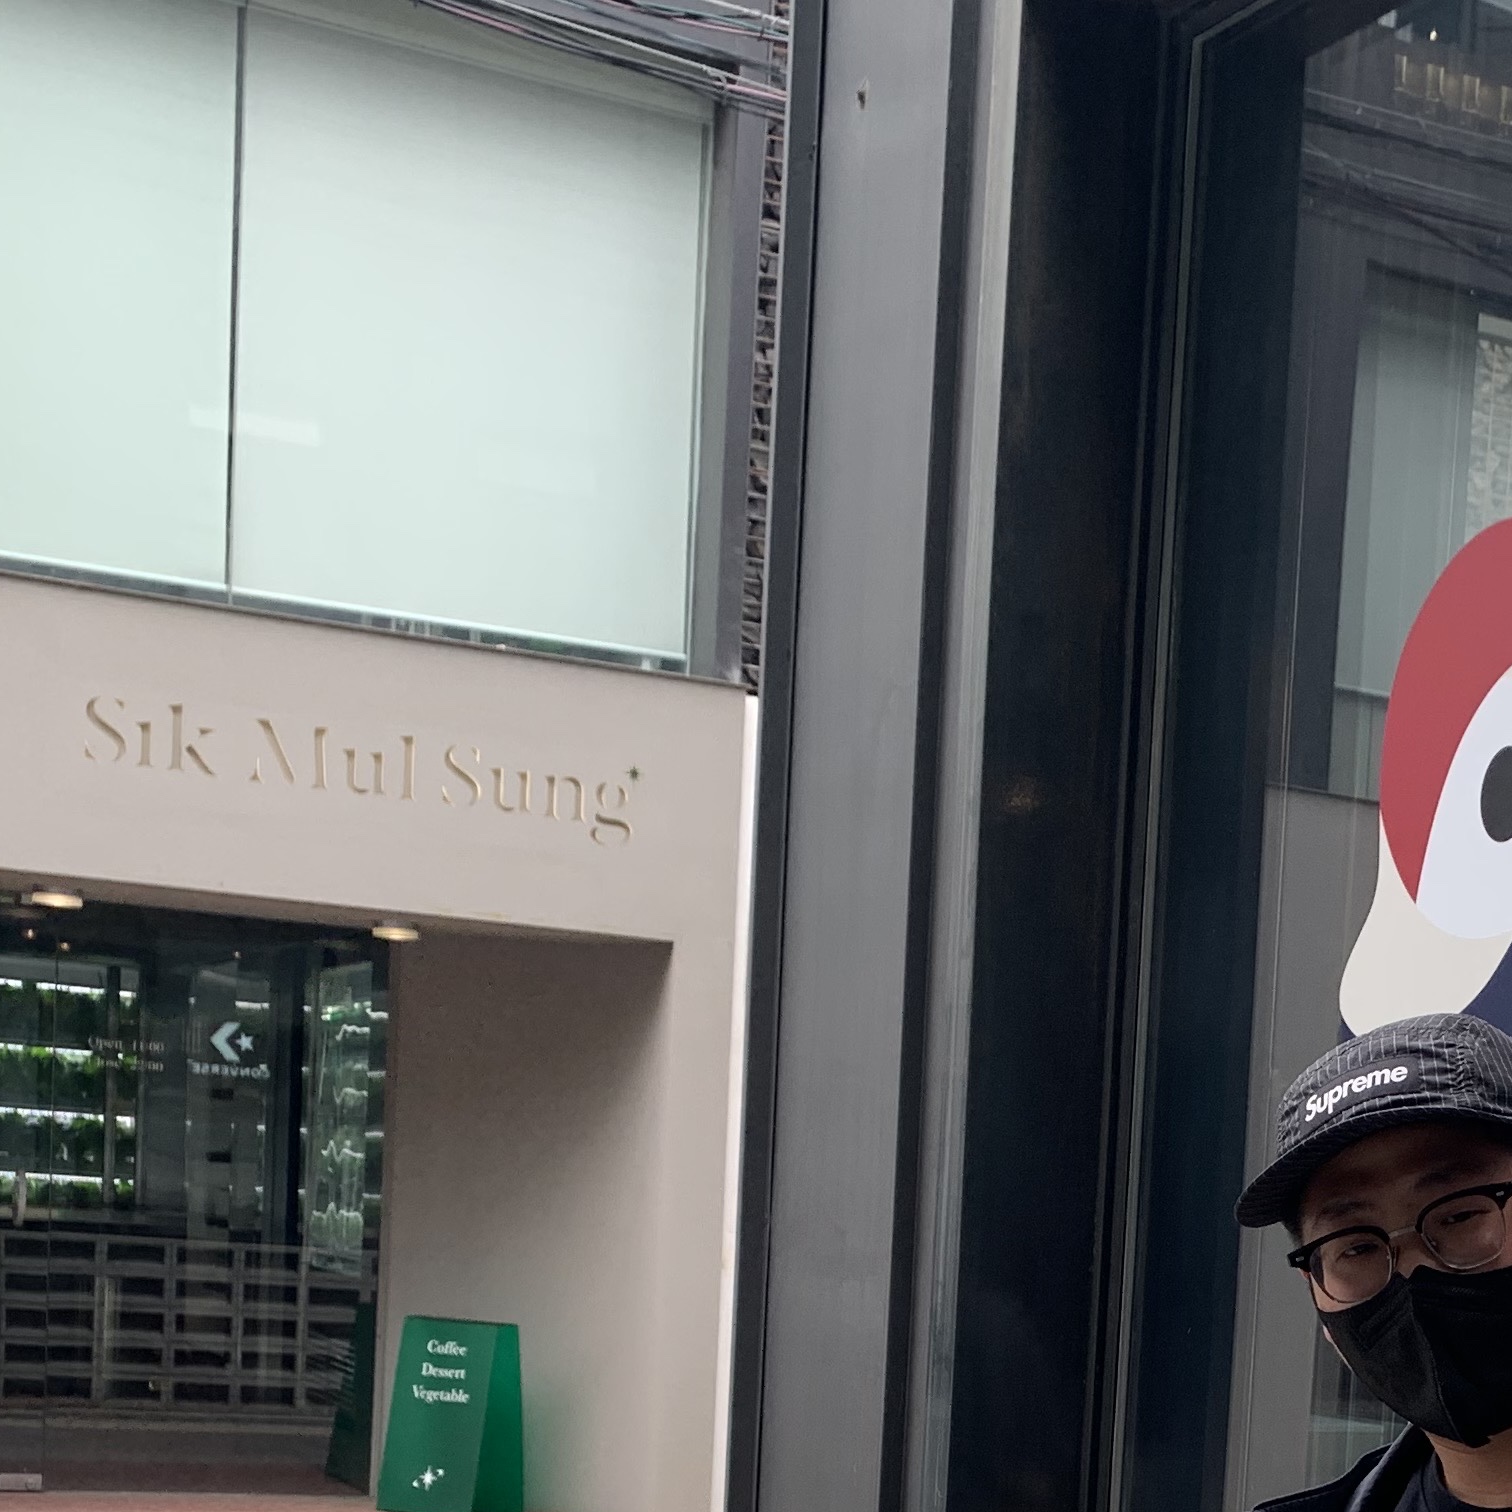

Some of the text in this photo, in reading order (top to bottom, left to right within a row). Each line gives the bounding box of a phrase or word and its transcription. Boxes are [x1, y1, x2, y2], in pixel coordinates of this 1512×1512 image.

[83, 696, 634, 846] Sik Mul Sung
[1304, 1065, 1409, 1122] Supreme
[426, 1338, 468, 1357] Coffee
[421, 1361, 467, 1380] Dessert
[411, 1384, 471, 1404] Vegetable
